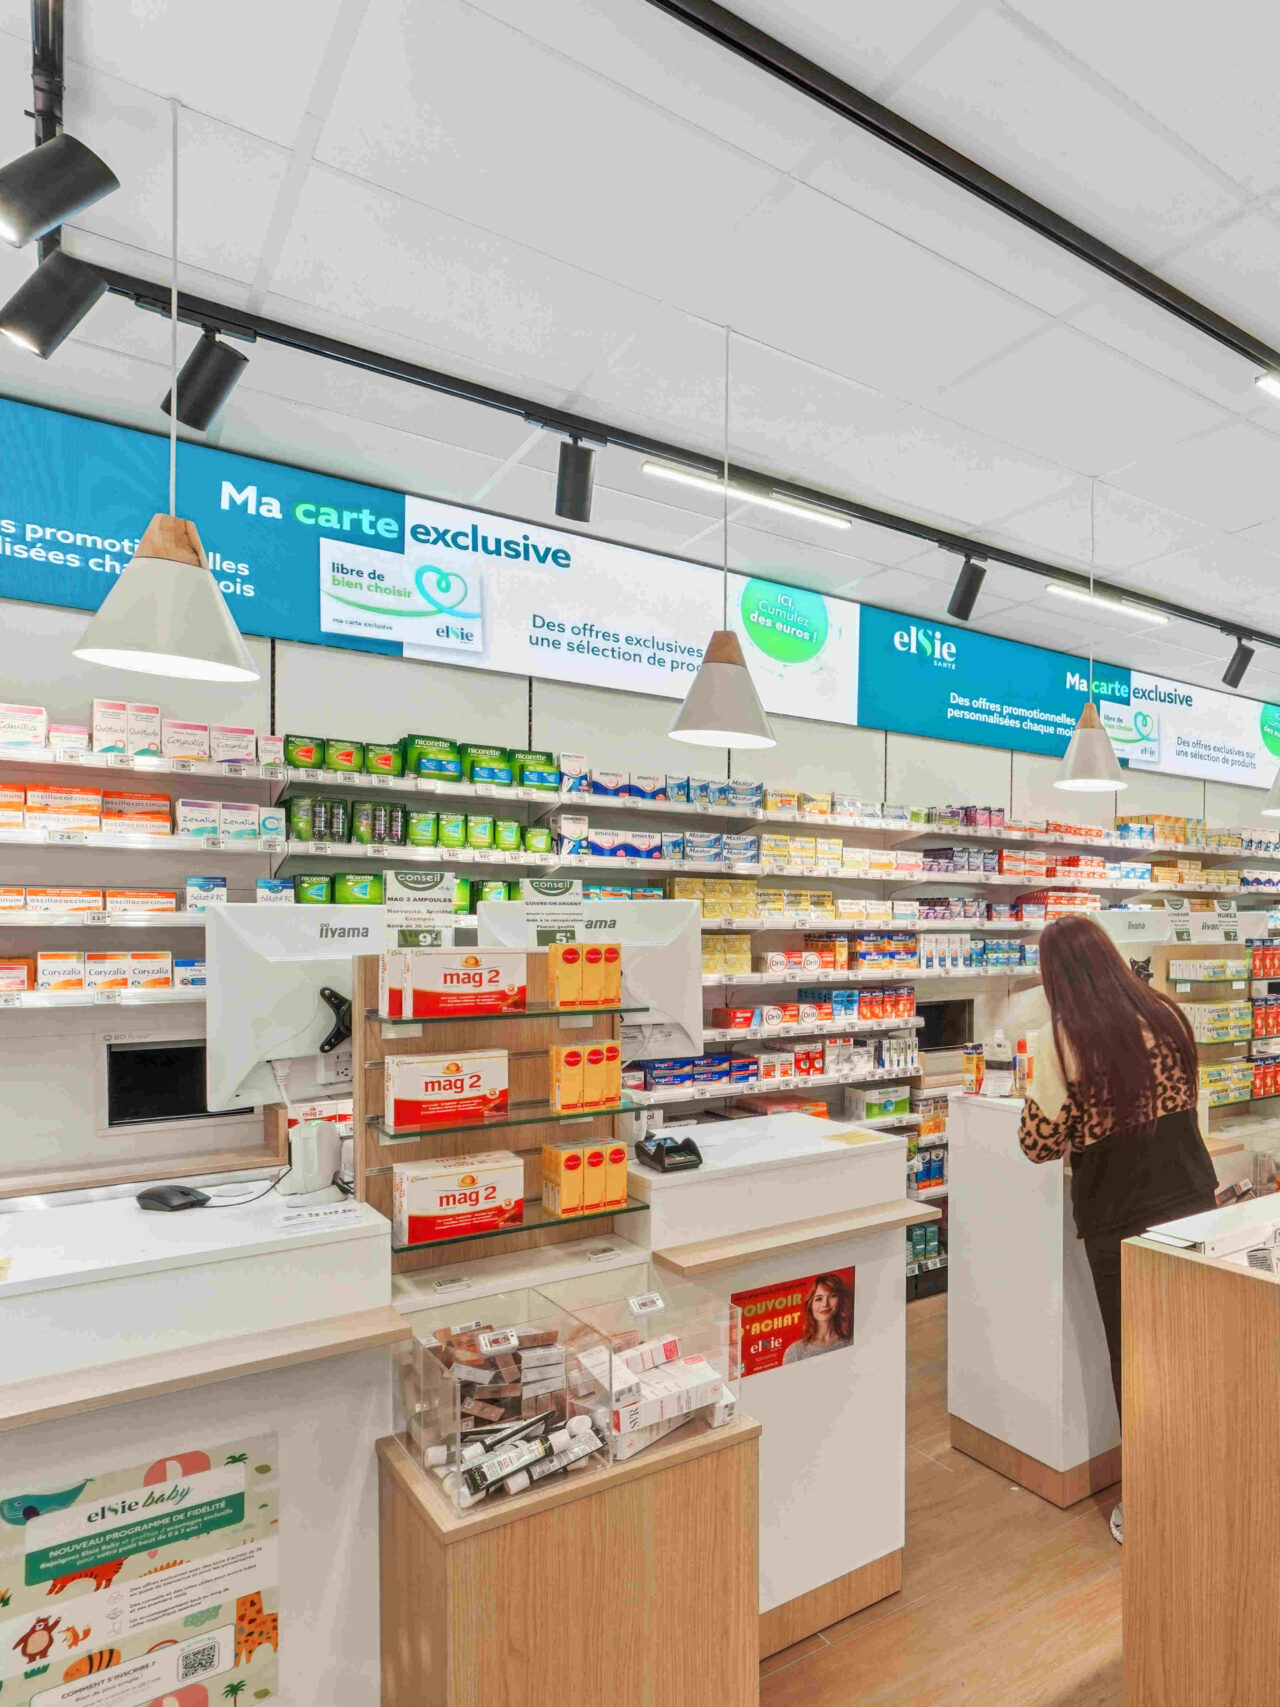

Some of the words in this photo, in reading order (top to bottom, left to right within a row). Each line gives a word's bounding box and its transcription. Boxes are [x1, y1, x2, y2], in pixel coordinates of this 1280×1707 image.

[220, 480, 283, 520] Ma
[294, 501, 400, 539] carte
[410, 519, 572, 569] exclusive
[331, 562, 364, 578] libre
[368, 569, 385, 582] de
[331, 576, 363, 591] bien
[367, 583, 412, 599] choisir
[758, 600, 810, 627] Cumulez
[532, 613, 566, 634] Des
[571, 622, 620, 643] offres
[624, 635, 704, 659] exclusives
[749, 612, 772, 628] des
[775, 620, 810, 641] euros
[529, 634, 561, 650] une
[567, 639, 642, 664] sélection
[646, 653, 666, 669] de
[1066, 672, 1088, 692] Ma
[1090, 678, 1129, 698] carte
[1132, 685, 1193, 707] exclusive
[950, 692, 970, 706] Des
[972, 698, 1001, 712] offres
[1003, 705, 1076, 726] promotionnelles
[947, 708, 1020, 729] personnalisées
[1022, 719, 1055, 735] chaque
[1056, 727, 1075, 738] moi
[415, 738, 450, 749] nicorette
[468, 747, 501, 757] nicorette
[1177, 736, 1190, 747] Des
[1191, 738, 1211, 751] offres
[1213, 743, 1245, 758] exclusives
[1245, 750, 1256, 758] sur
[515, 752, 547, 762] nicorette
[1175, 748, 1189, 758] une
[1190, 749, 1220, 764] sélection
[1221, 754, 1230, 765] de
[1230, 757, 1257, 769] produits
[300, 875, 331, 884] nicorette
[345, 873, 374, 882] nicorette
[397, 872, 441, 883] conseil
[533, 880, 571, 889] conseil
[319, 923, 370, 939] iiyama
[132, 967, 169, 976] Coryzalia
[771, 959, 787, 967] Drill
[805, 958, 819, 966] Drill
[41, 968, 82, 978] Coryzalia
[88, 968, 127, 977] Coryzalia
[443, 971, 483, 988] mag
[487, 969, 500, 984] 2
[768, 1013, 781, 1021] Drill
[804, 1011, 817, 1019] Drill
[424, 1075, 465, 1096] mag
[469, 1074, 482, 1089] 2
[302, 1110, 316, 1119] mag
[438, 1190, 479, 1208] mag
[483, 1186, 497, 1201] 2
[743, 1293, 802, 1318] OUVOIR
[141, 1484, 194, 1509] baby
[49, 1536, 104, 1559] NOUVEAU
[105, 1516, 171, 1542] PROGRAMME
[172, 1511, 186, 1522] DE
[187, 1500, 226, 1518] FIDÉLITÉ
[61, 1680, 106, 1700] COMMENT
